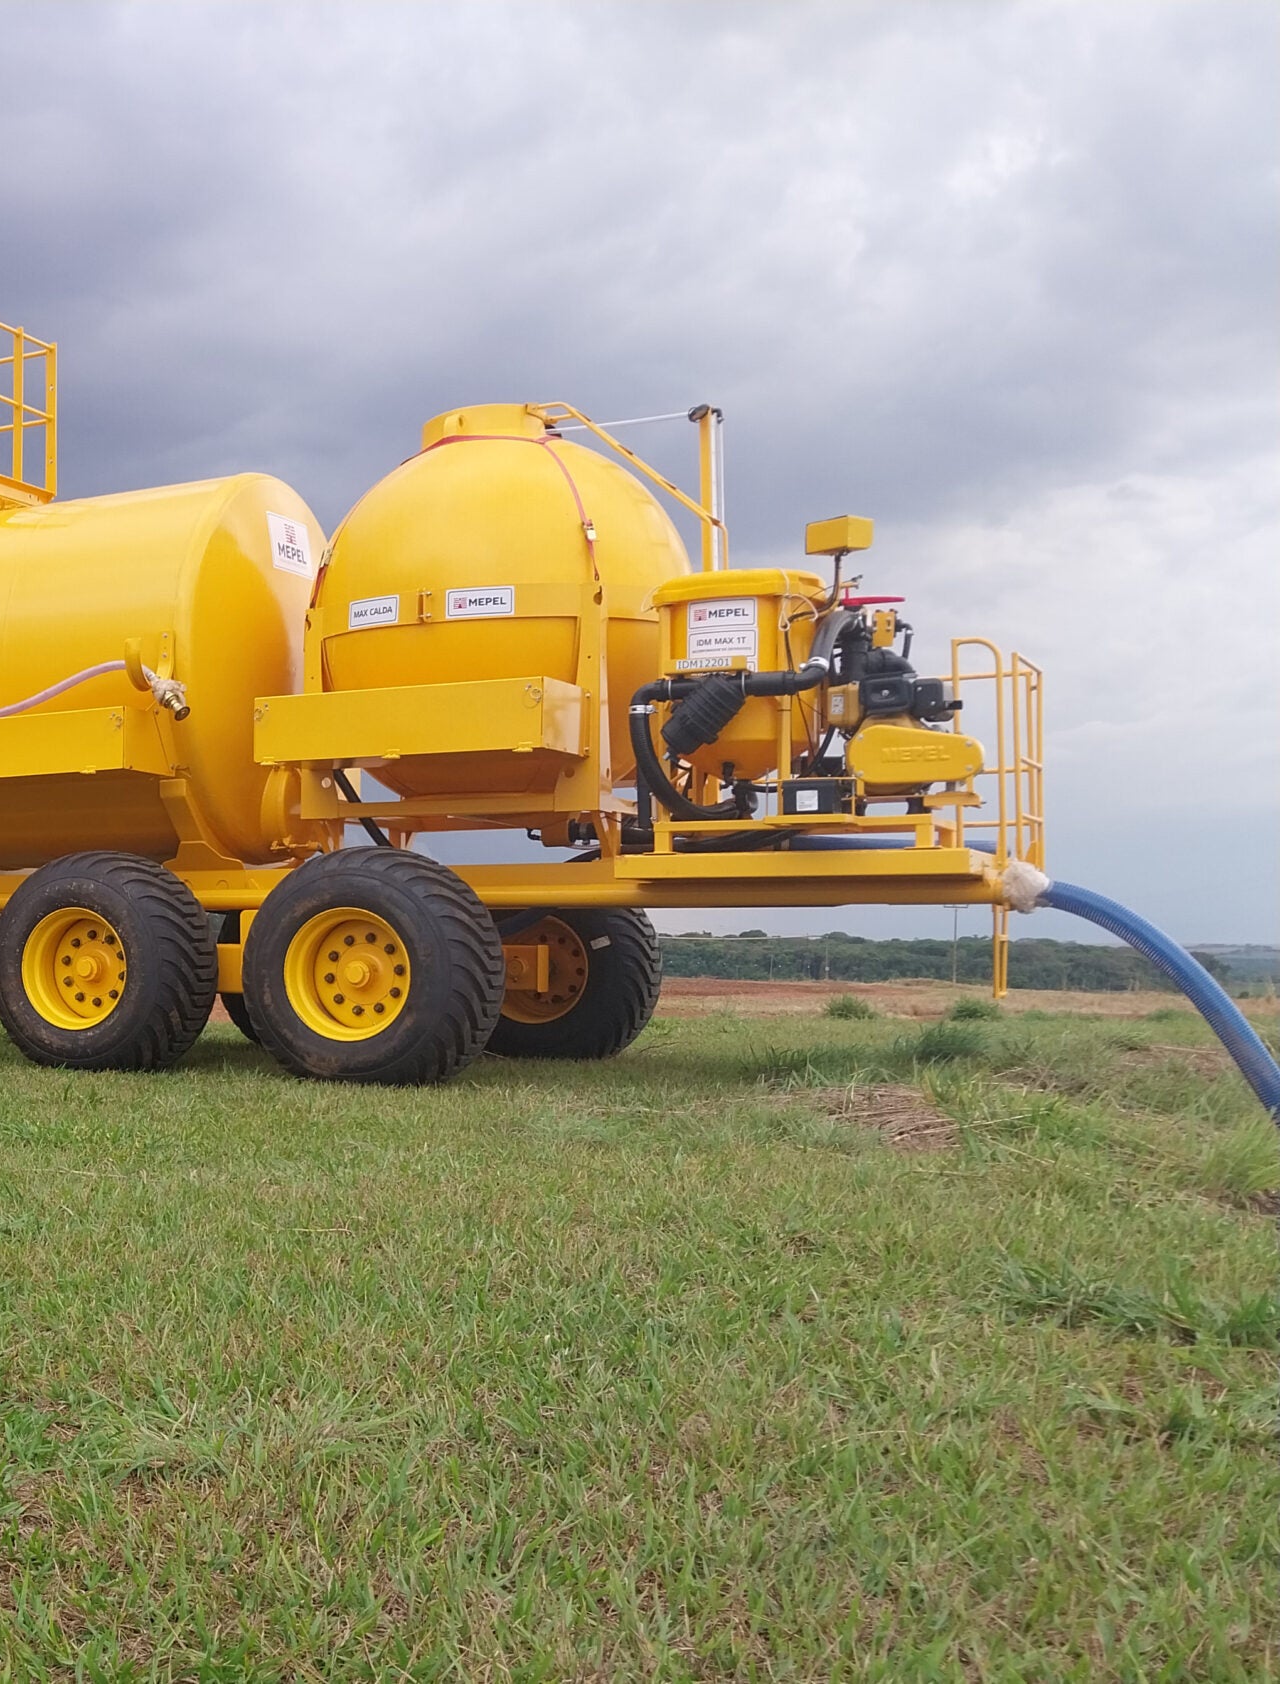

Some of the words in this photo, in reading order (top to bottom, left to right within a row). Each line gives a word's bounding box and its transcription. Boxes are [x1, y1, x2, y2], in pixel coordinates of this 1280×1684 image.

[278, 542, 307, 565] MEPEL
[468, 596, 507, 607] MEPEL
[353, 609, 368, 618] MAX
[369, 605, 393, 616] CALDA
[708, 608, 749, 619] MEPEL
[696, 638, 712, 647] IDM
[714, 636, 734, 645] MAX
[736, 636, 746, 644] 1T
[677, 658, 730, 670] IDM12201
[880, 745, 951, 764] MEPEL
